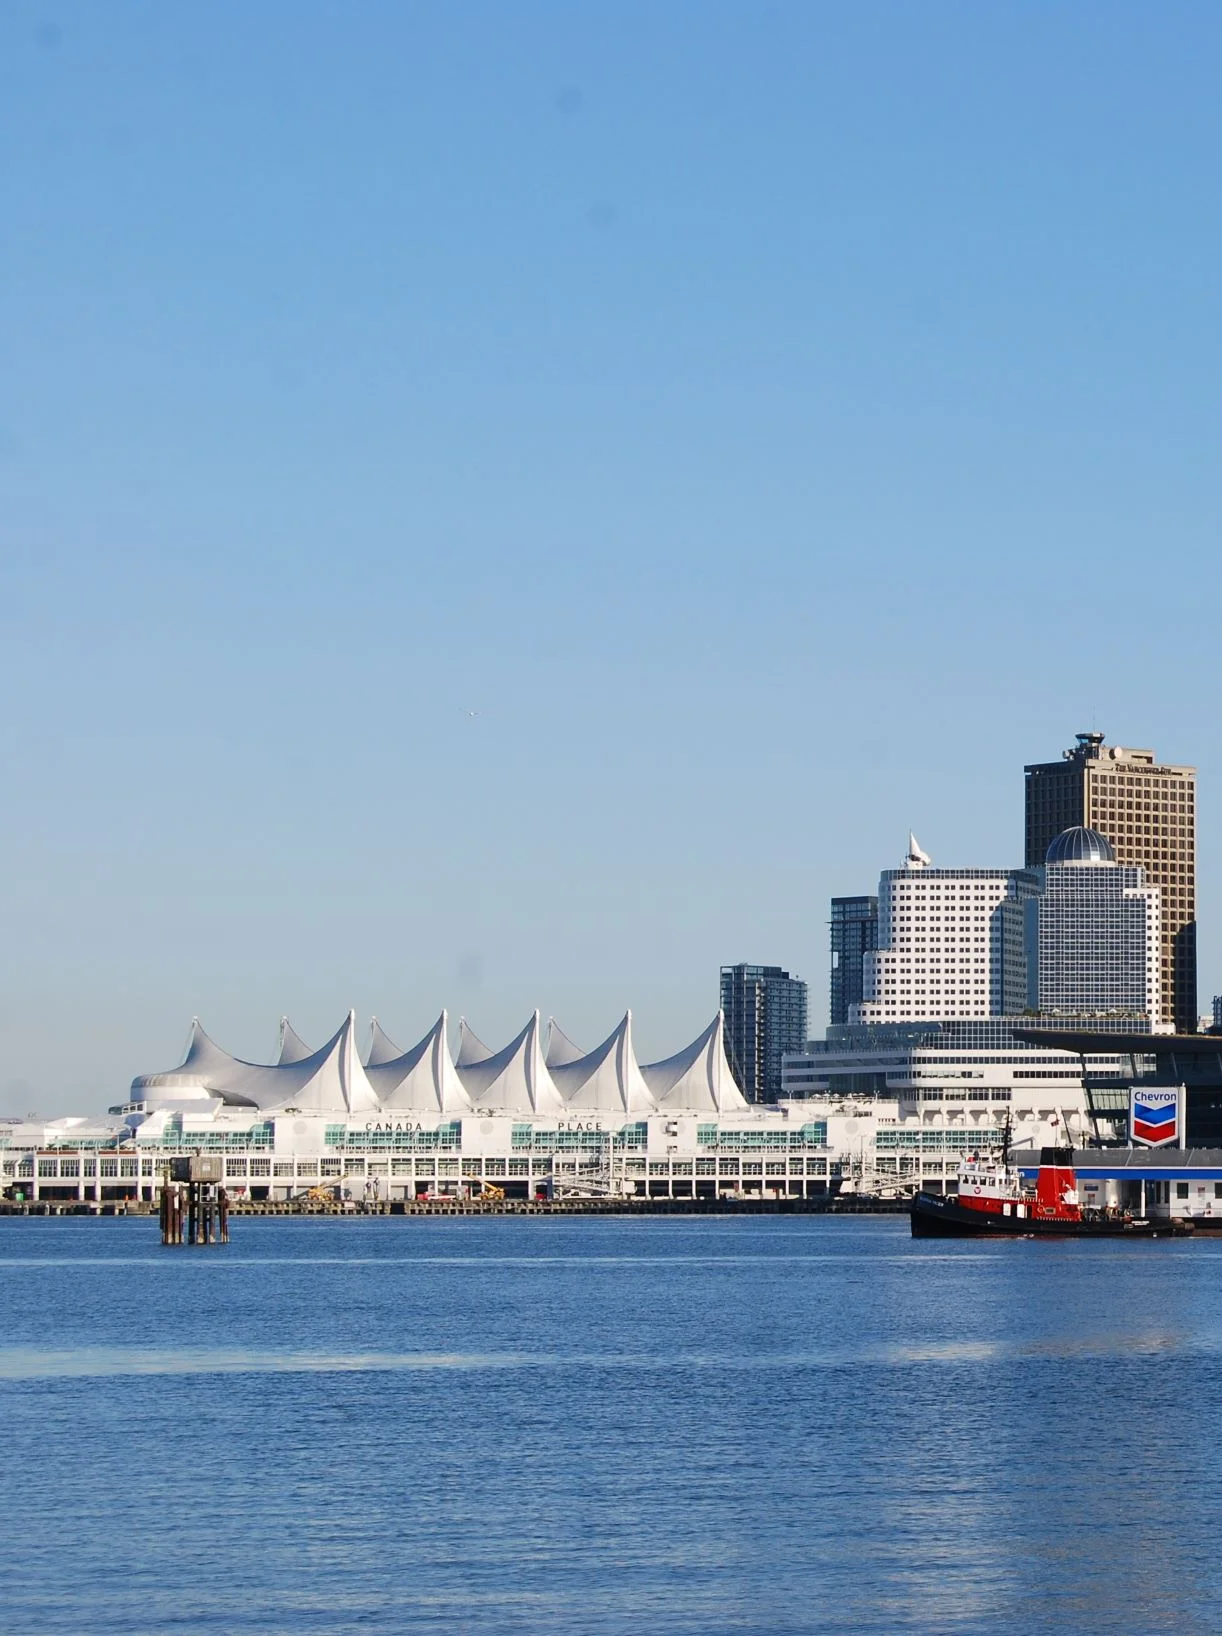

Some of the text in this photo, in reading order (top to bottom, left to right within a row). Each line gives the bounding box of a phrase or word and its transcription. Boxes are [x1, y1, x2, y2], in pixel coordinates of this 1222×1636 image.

[1134, 1091, 1177, 1101] Chevron
[365, 1122, 602, 1131] CANADA PLACE
